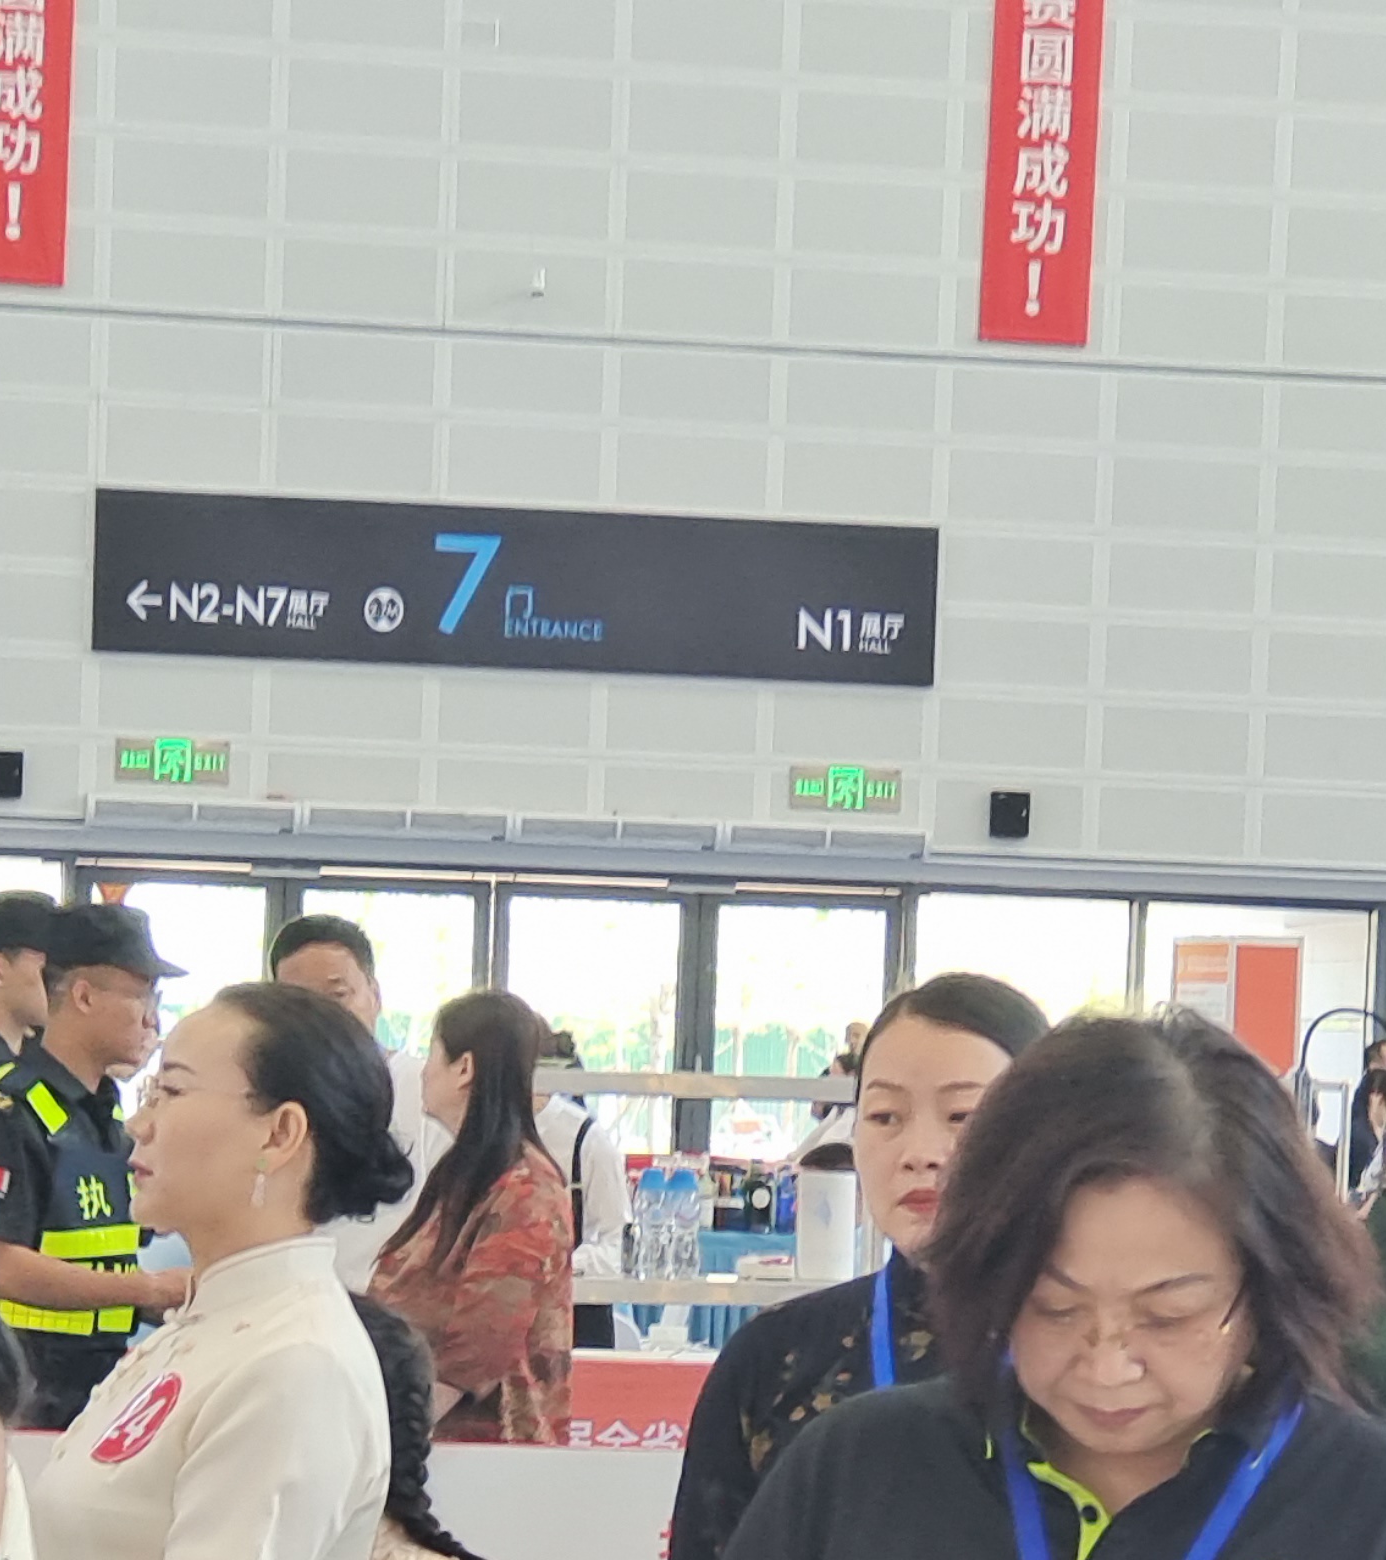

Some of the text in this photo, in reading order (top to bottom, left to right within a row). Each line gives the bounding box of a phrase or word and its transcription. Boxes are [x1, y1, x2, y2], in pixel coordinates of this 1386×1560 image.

[169, 580, 289, 629] N2-N7
[434, 532, 503, 636] 7
[504, 616, 604, 642] ENTRANCE
[796, 606, 852, 652] N1
